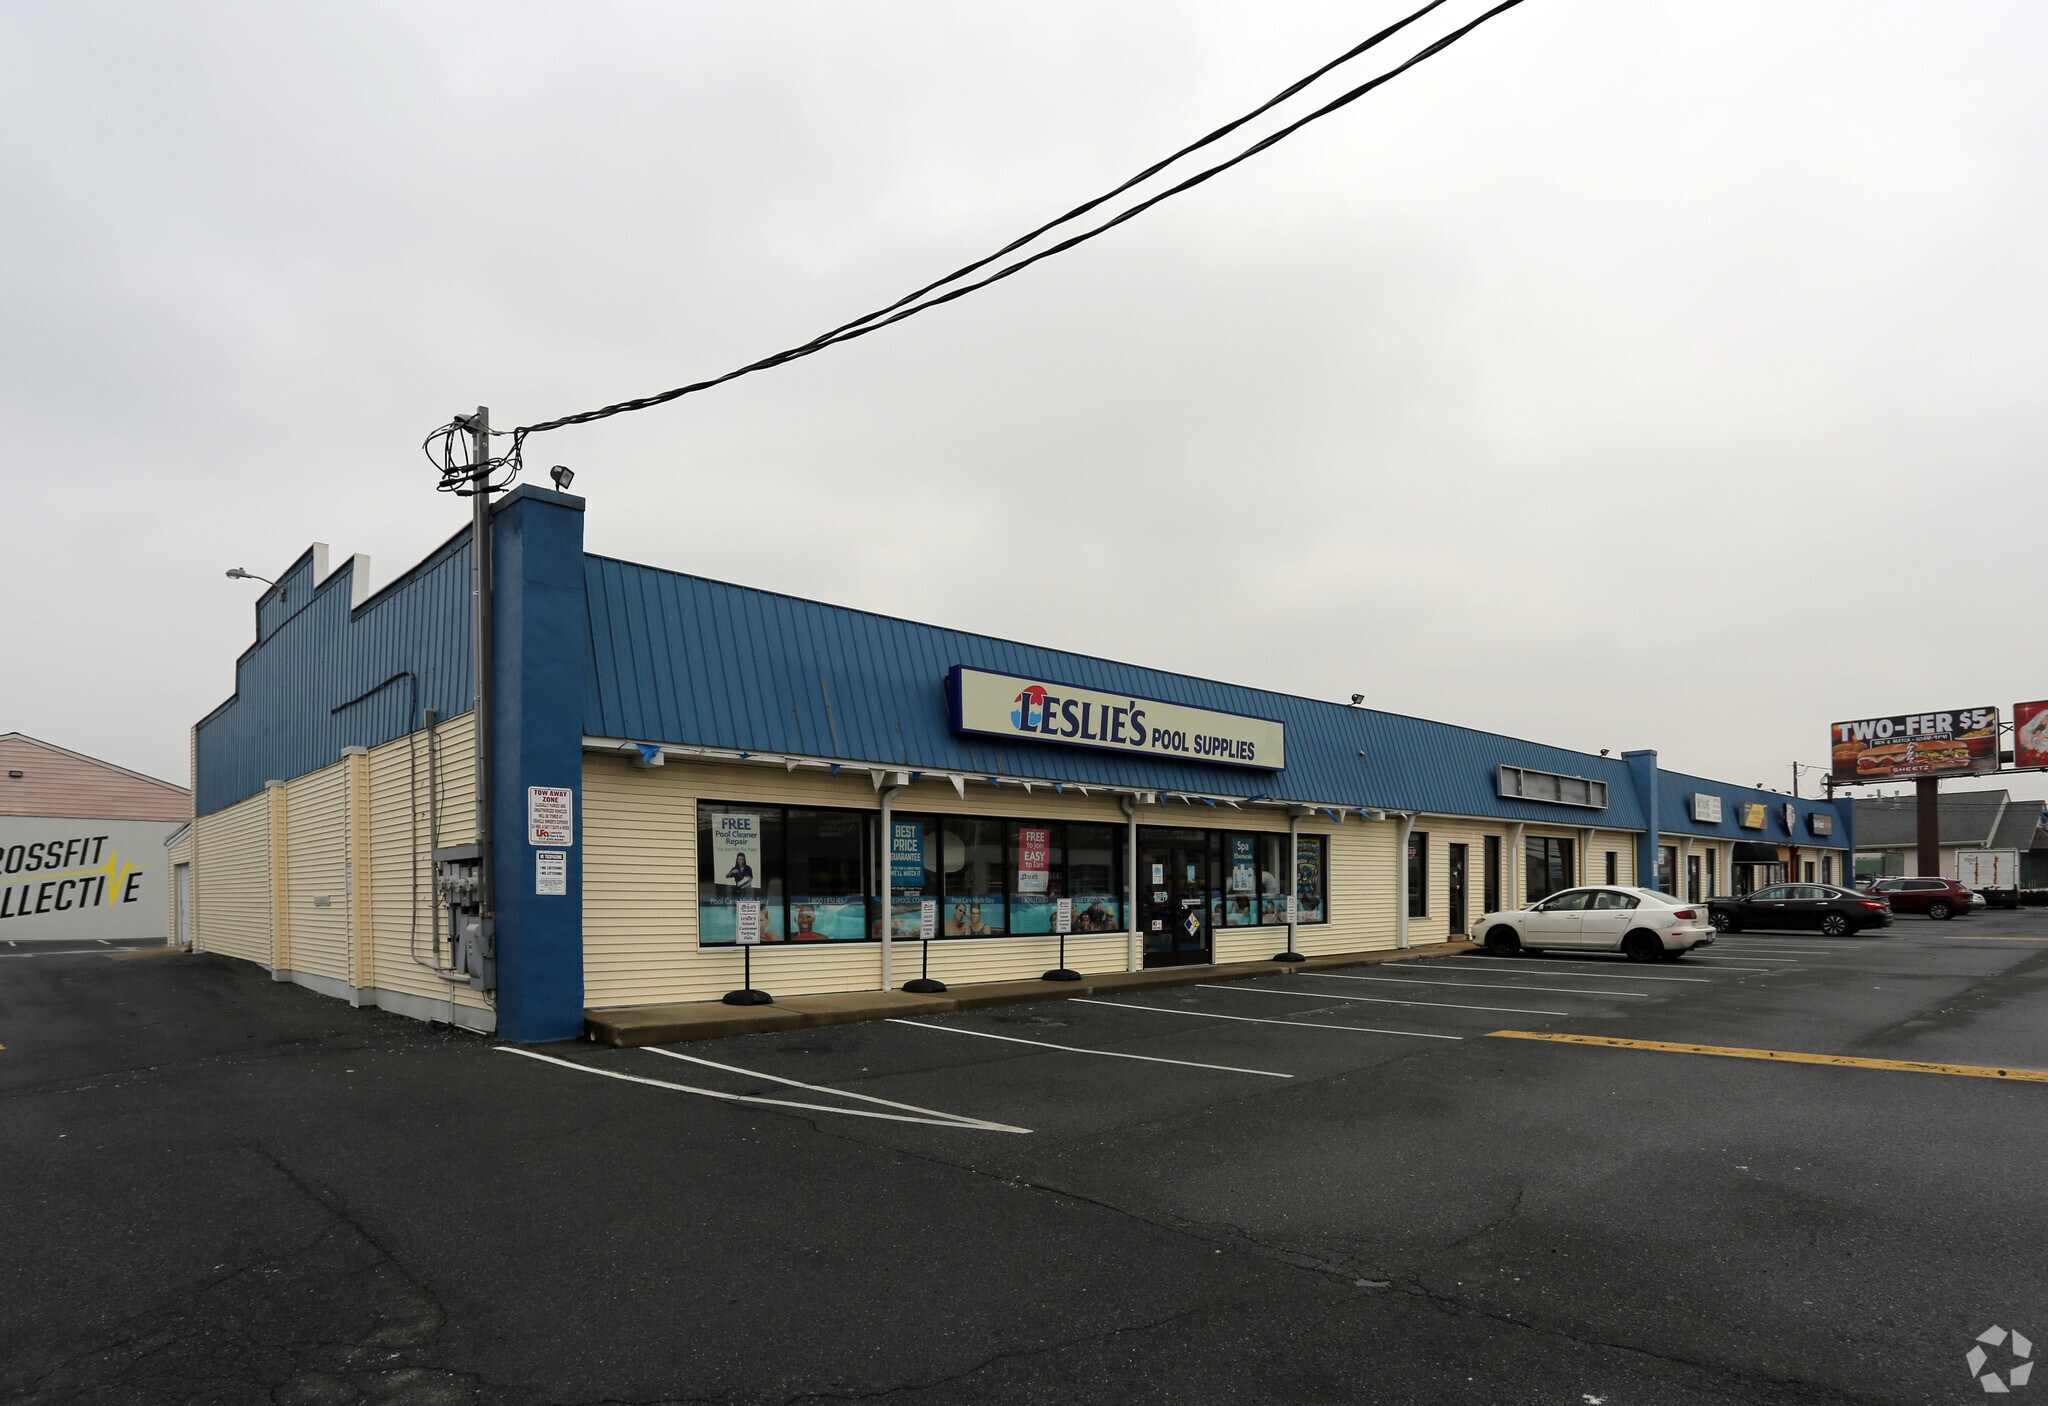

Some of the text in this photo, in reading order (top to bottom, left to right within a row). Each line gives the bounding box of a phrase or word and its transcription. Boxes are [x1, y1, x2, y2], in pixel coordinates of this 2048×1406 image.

[1018, 691, 1255, 760] LESLIE'S POOL SUPPLIES
[1839, 709, 1987, 741] TWO-FER $5
[1892, 764, 1930, 773] SHEETZ
[722, 818, 751, 830] FREE
[895, 825, 916, 838] BEST
[1026, 831, 1045, 841] FREE
[726, 838, 748, 846] Repair
[894, 838, 918, 852] PRICE
[1237, 841, 1249, 853] Spa
[0, 836, 108, 875] OSSFIT
[890, 852, 921, 861] GUARANTEE
[1024, 851, 1045, 861] EASY
[0, 871, 143, 919] LLECTIVE
